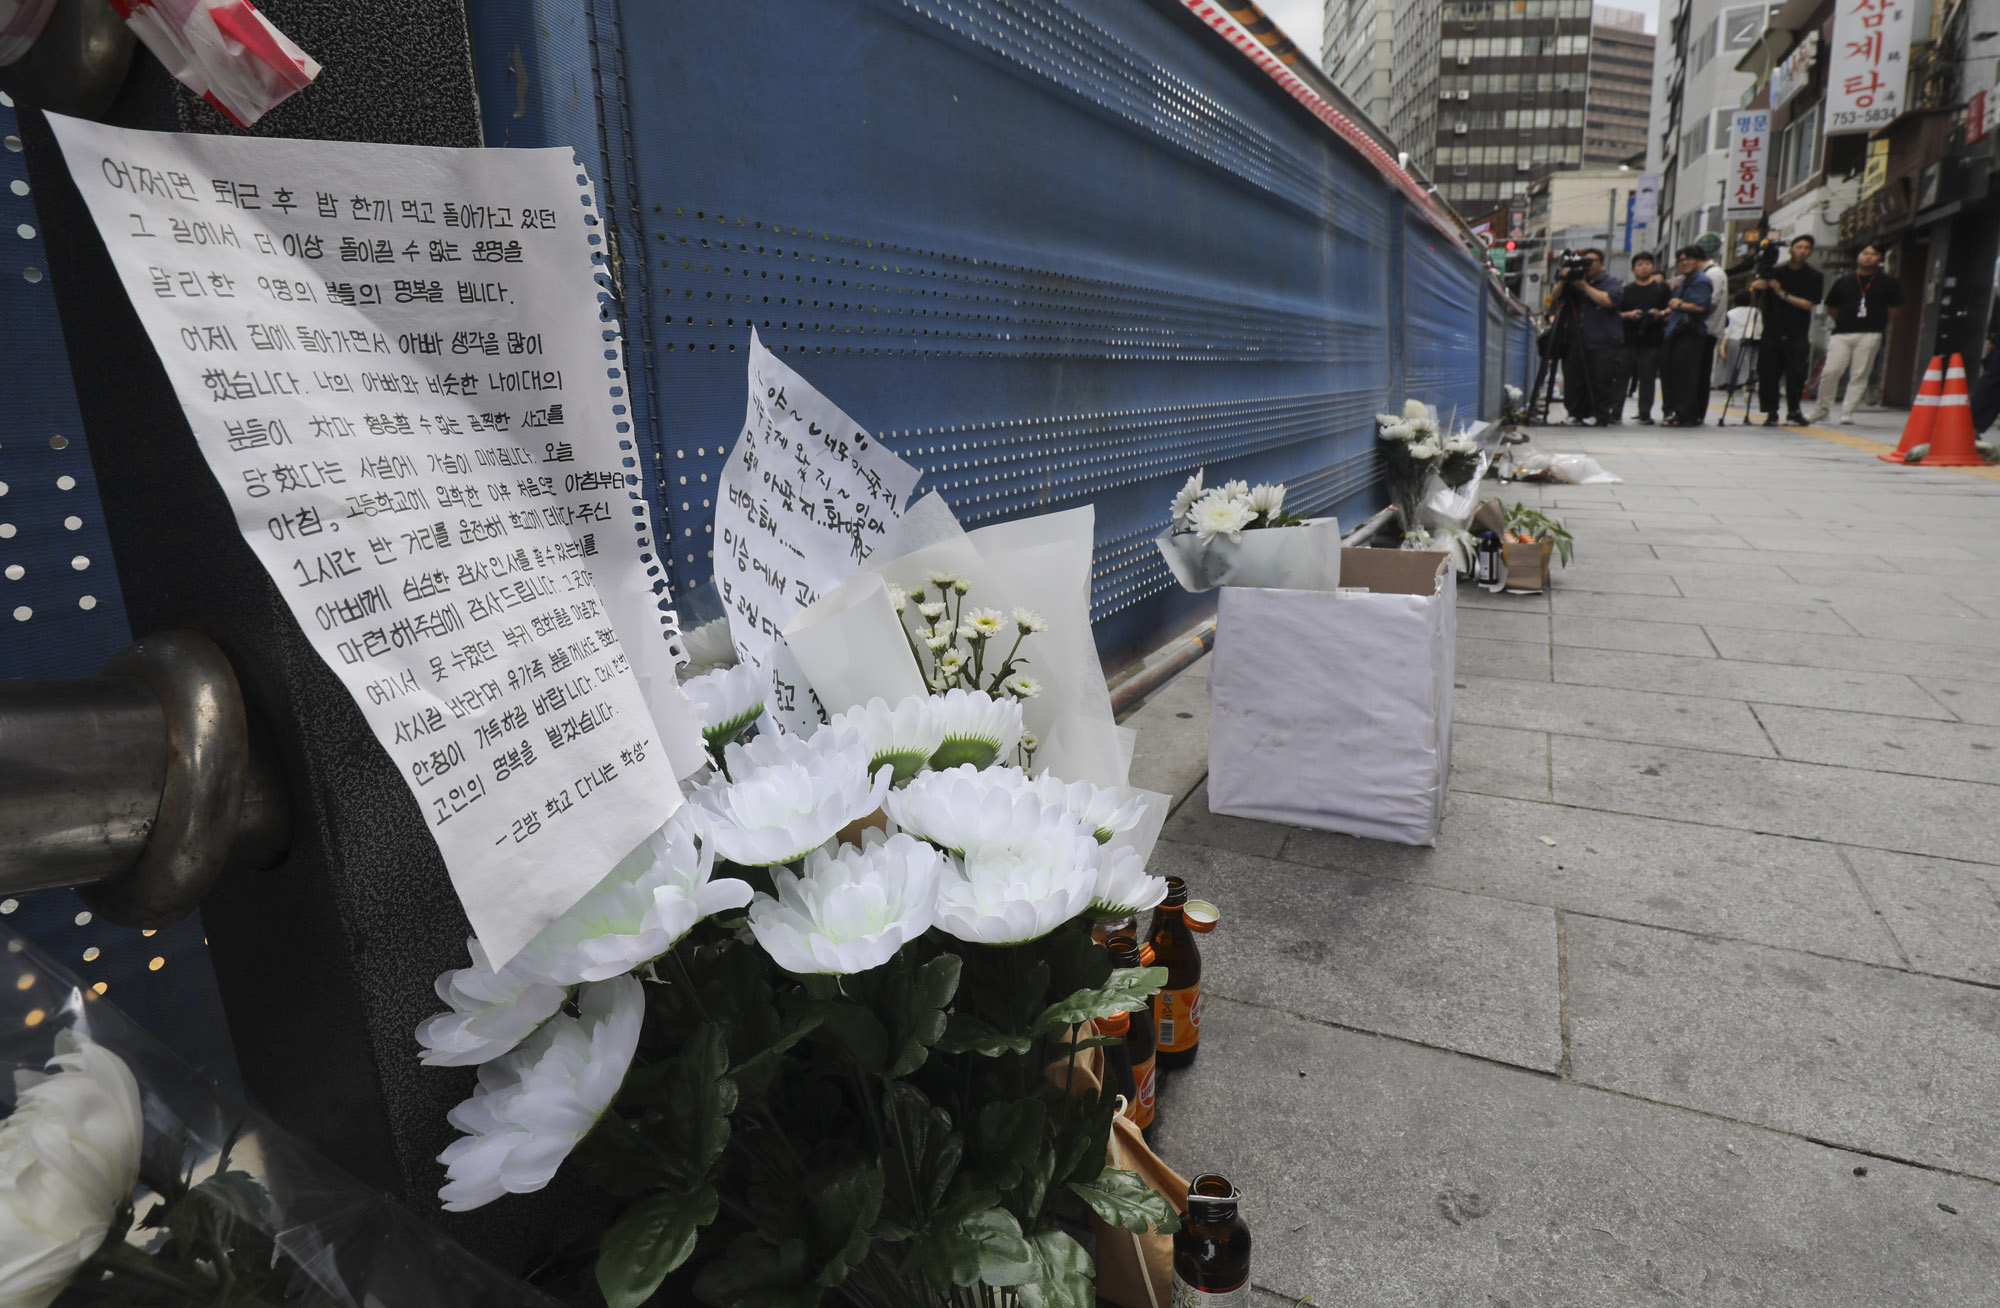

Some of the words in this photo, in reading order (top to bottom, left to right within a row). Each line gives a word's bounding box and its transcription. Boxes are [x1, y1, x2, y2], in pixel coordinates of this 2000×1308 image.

[1842, 0, 1896, 108] 삼계탕
[1832, 107, 1897, 126] 753-5834
[101, 156, 200, 202] 어쩌면
[211, 178, 262, 210] 퇴근
[271, 186, 298, 215] 후
[316, 191, 339, 219] 밥
[350, 194, 393, 223] 한끼
[401, 199, 436, 224] 먹고
[443, 202, 514, 230] 돌아가고
[520, 208, 557, 230] 있던
[1734, 136, 1762, 205] 부동산
[129, 213, 157, 238] 그
[168, 217, 242, 249] 길에서
[254, 233, 278, 256] 더
[282, 233, 324, 260] 이상
[339, 236, 396, 264] 돌이킬
[401, 240, 421, 263] 수
[429, 239, 462, 263] 없는
[472, 240, 524, 264] 운명을
[148, 266, 236, 299] 달리한
[257, 275, 318, 304] 9명의
[325, 281, 382, 307] 분들의
[393, 279, 444, 304] 명복을
[457, 280, 515, 306] 빕니다.
[180, 324, 239, 352] 어제
[246, 323, 297, 351] 집에
[296, 325, 392, 355] 돌아가면서
[398, 331, 444, 356] 아빠
[451, 331, 501, 356] 생각을
[507, 331, 544, 356] 많이
[201, 367, 310, 403] 했습니다.
[312, 370, 356, 394] 나의
[361, 371, 420, 395] 아빠와
[425, 372, 480, 397] 비슷한
[488, 369, 564, 392] 나이대의
[223, 418, 294, 452] 분들이
[308, 414, 357, 439] 차마
[363, 411, 415, 436] 형용할
[419, 413, 433, 436] 수
[434, 413, 465, 437] 없는
[466, 411, 512, 433] 끔찍한
[521, 403, 565, 429] 사고를
[241, 460, 348, 499] 당했다는
[360, 454, 419, 481] 사실에
[425, 451, 473, 477] 가슴이
[542, 440, 576, 463] 오늘
[267, 505, 341, 542] 아침,
[345, 486, 431, 520] 고등학교에
[435, 483, 484, 509] 입학한
[486, 481, 512, 503] 이후
[565, 470, 626, 494] 아침부터
[292, 547, 363, 589] 1시간
[367, 536, 398, 566] 반
[399, 520, 453, 555] 거리를
[458, 513, 509, 545] 운전해
[314, 583, 393, 632] 아빠께
[402, 567, 452, 602] 심심한
[456, 547, 535, 586] 감사인사를
[466, 574, 563, 623] 감사드립니다.
[365, 667, 423, 706] 여기서
[428, 655, 450, 684] 못
[449, 637, 500, 673] 누렸던
[501, 623, 534, 649] 부귀
[393, 706, 448, 746] 사시길
[506, 657, 548, 692] 유가족
[410, 740, 467, 788] 안정이
[473, 704, 531, 751] 가득하길
[531, 674, 599, 718] 바랍니다.
[593, 662, 617, 684] 다시
[431, 773, 488, 827] 고인의
[492, 739, 539, 783] 명복을
[543, 700, 621, 752] 빌겠습니다.
[544, 789, 575, 820] 학교
[574, 762, 620, 800] 다니는
